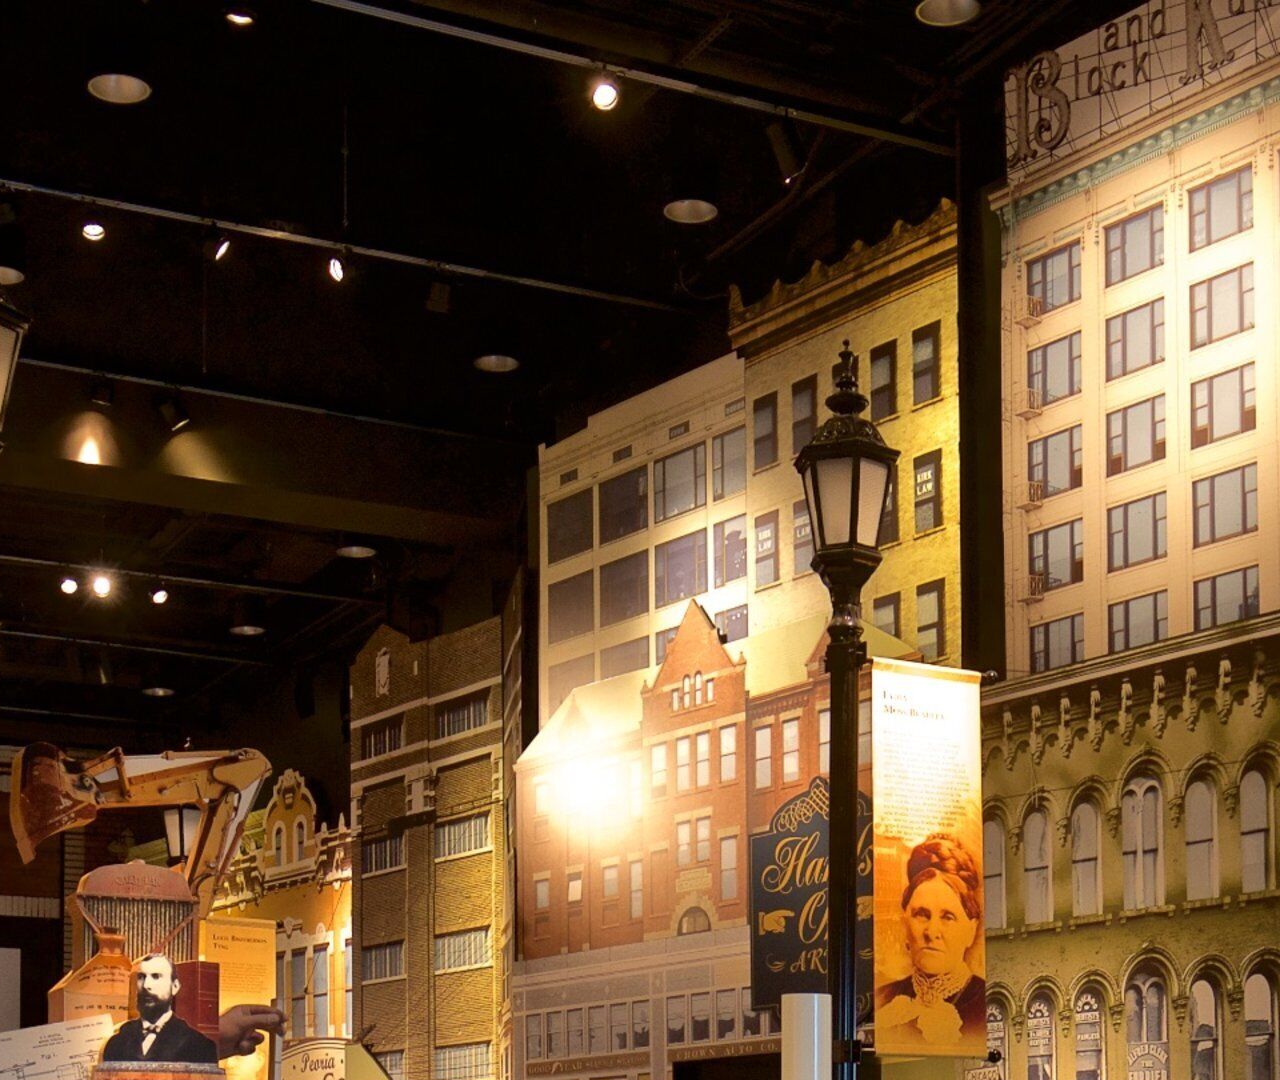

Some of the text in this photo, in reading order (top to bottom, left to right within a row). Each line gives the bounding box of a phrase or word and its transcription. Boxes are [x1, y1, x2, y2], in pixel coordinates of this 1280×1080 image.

[1104, 6, 1169, 52] and
[1005, 41, 1152, 168] Block
[300, 1052, 336, 1074] Peoria
[760, 1043, 779, 1052] CO.
